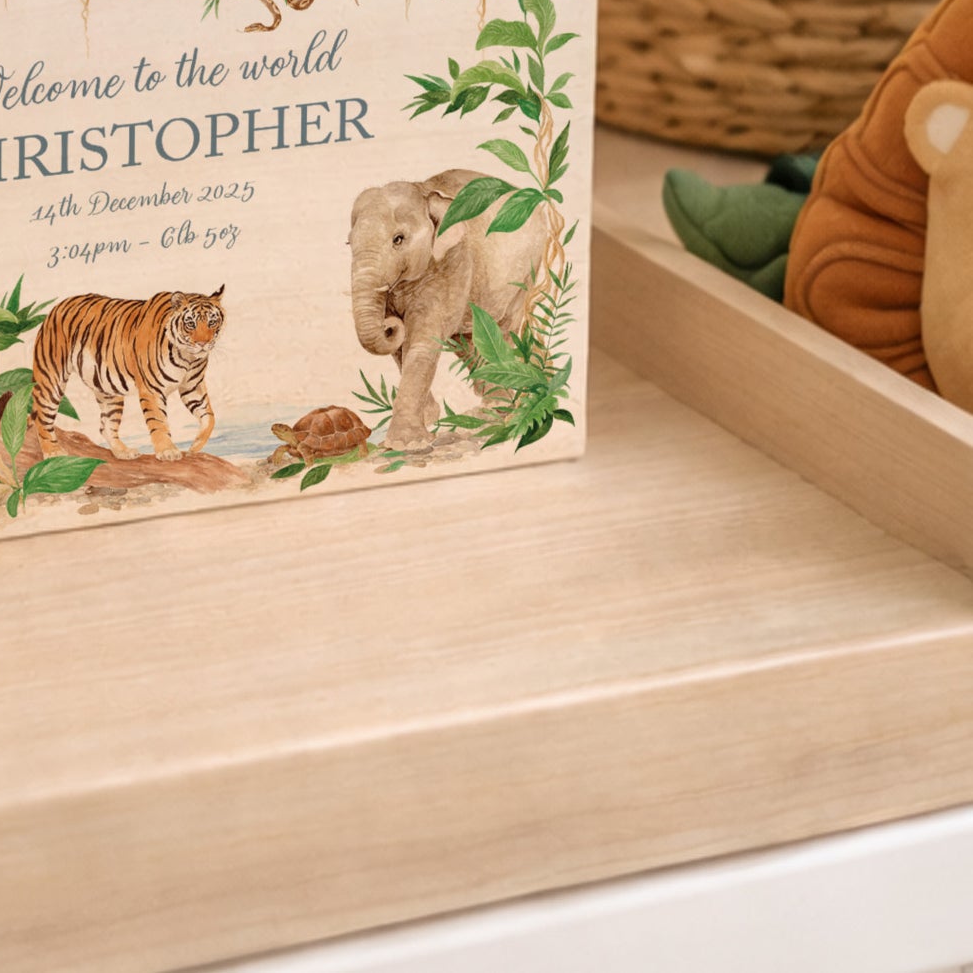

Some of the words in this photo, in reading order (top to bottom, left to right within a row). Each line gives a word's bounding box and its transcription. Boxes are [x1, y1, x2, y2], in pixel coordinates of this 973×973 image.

[133, 56, 167, 93] to
[175, 47, 230, 88] the
[239, 29, 348, 81] world
[29, 193, 82, 226] 14th
[87, 182, 194, 216] December
[197, 181, 256, 203] 2025
[47, 238, 132, 269] 3:04pm
[160, 219, 199, 249] 6lb
[202, 223, 242, 250] 5oz
